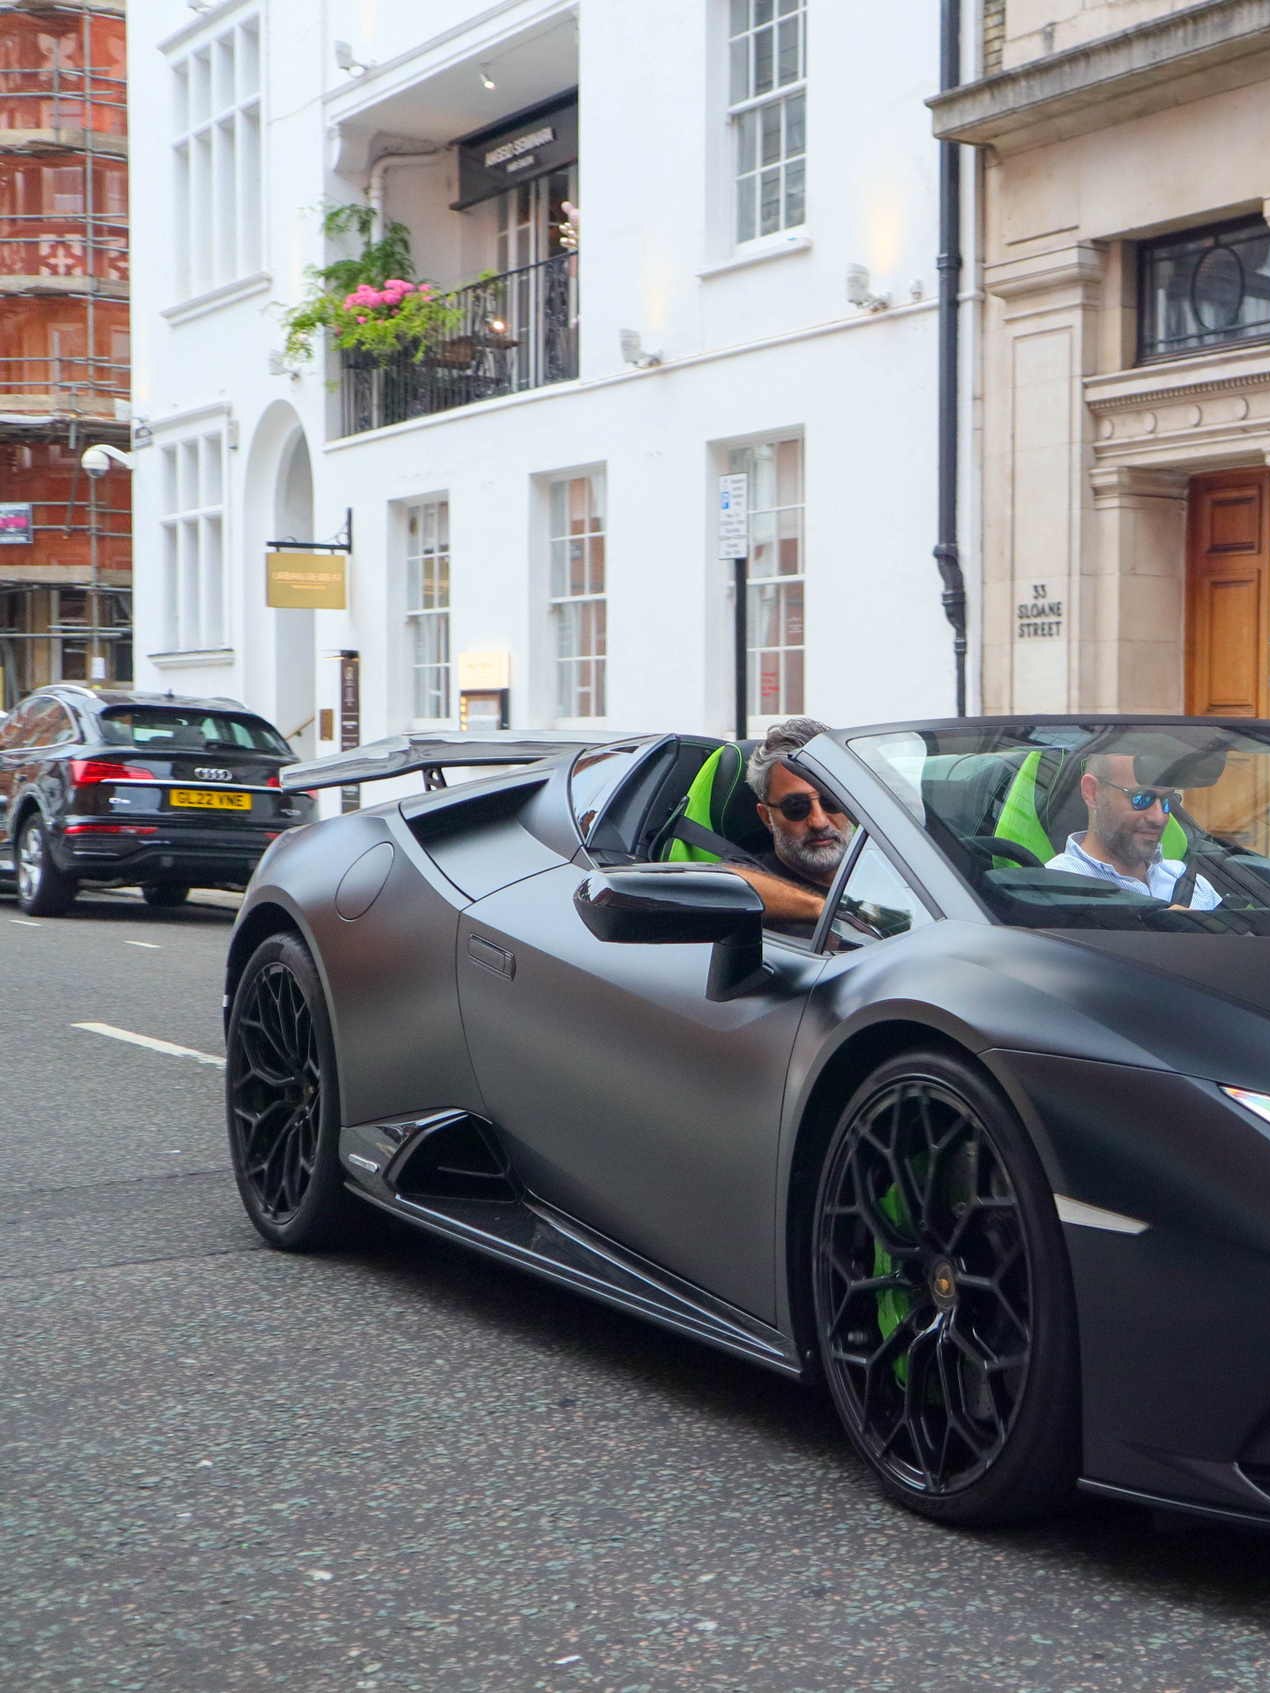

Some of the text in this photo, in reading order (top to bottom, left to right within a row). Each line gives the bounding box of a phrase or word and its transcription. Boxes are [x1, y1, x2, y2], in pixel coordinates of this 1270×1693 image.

[1032, 584, 1047, 600] 33
[1017, 601, 1062, 619] SLOANE
[1018, 621, 1062, 638] STREET
[177, 791, 244, 807] GL22 VNE
